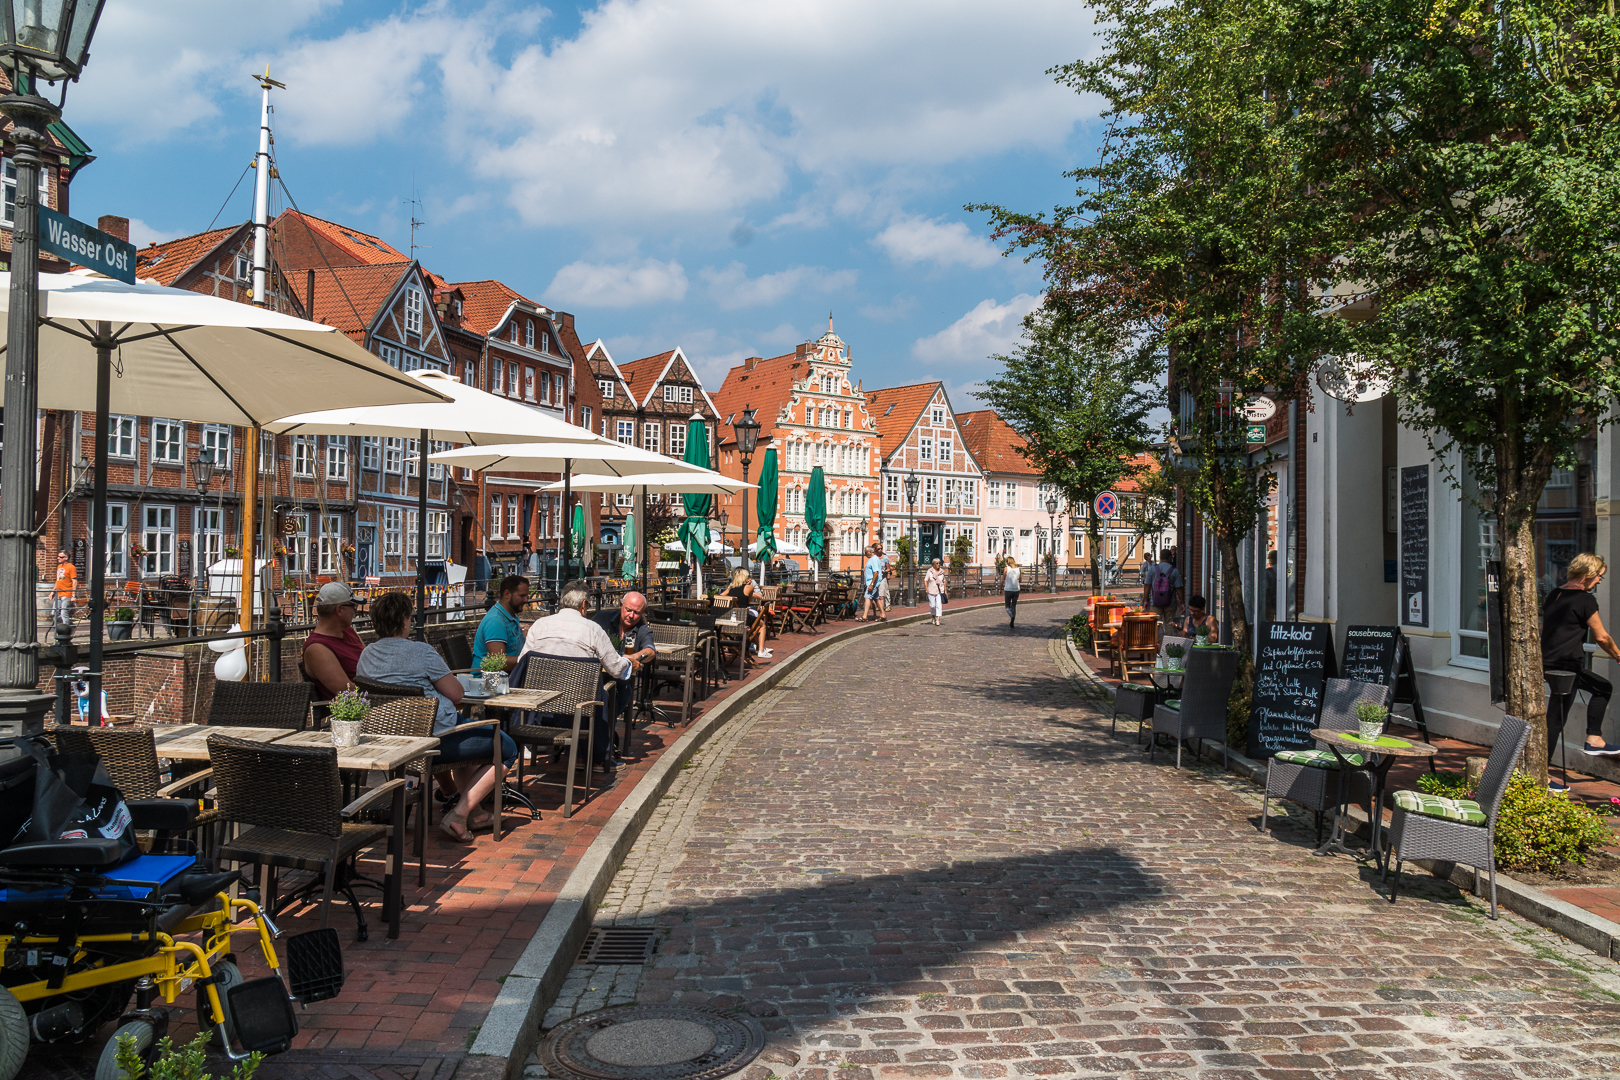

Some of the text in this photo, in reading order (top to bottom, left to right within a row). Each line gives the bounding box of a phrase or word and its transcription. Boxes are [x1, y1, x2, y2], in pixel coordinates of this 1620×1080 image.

[48, 217, 128, 272] Wasser Ost
[1270, 624, 1313, 641] fritz-kola
